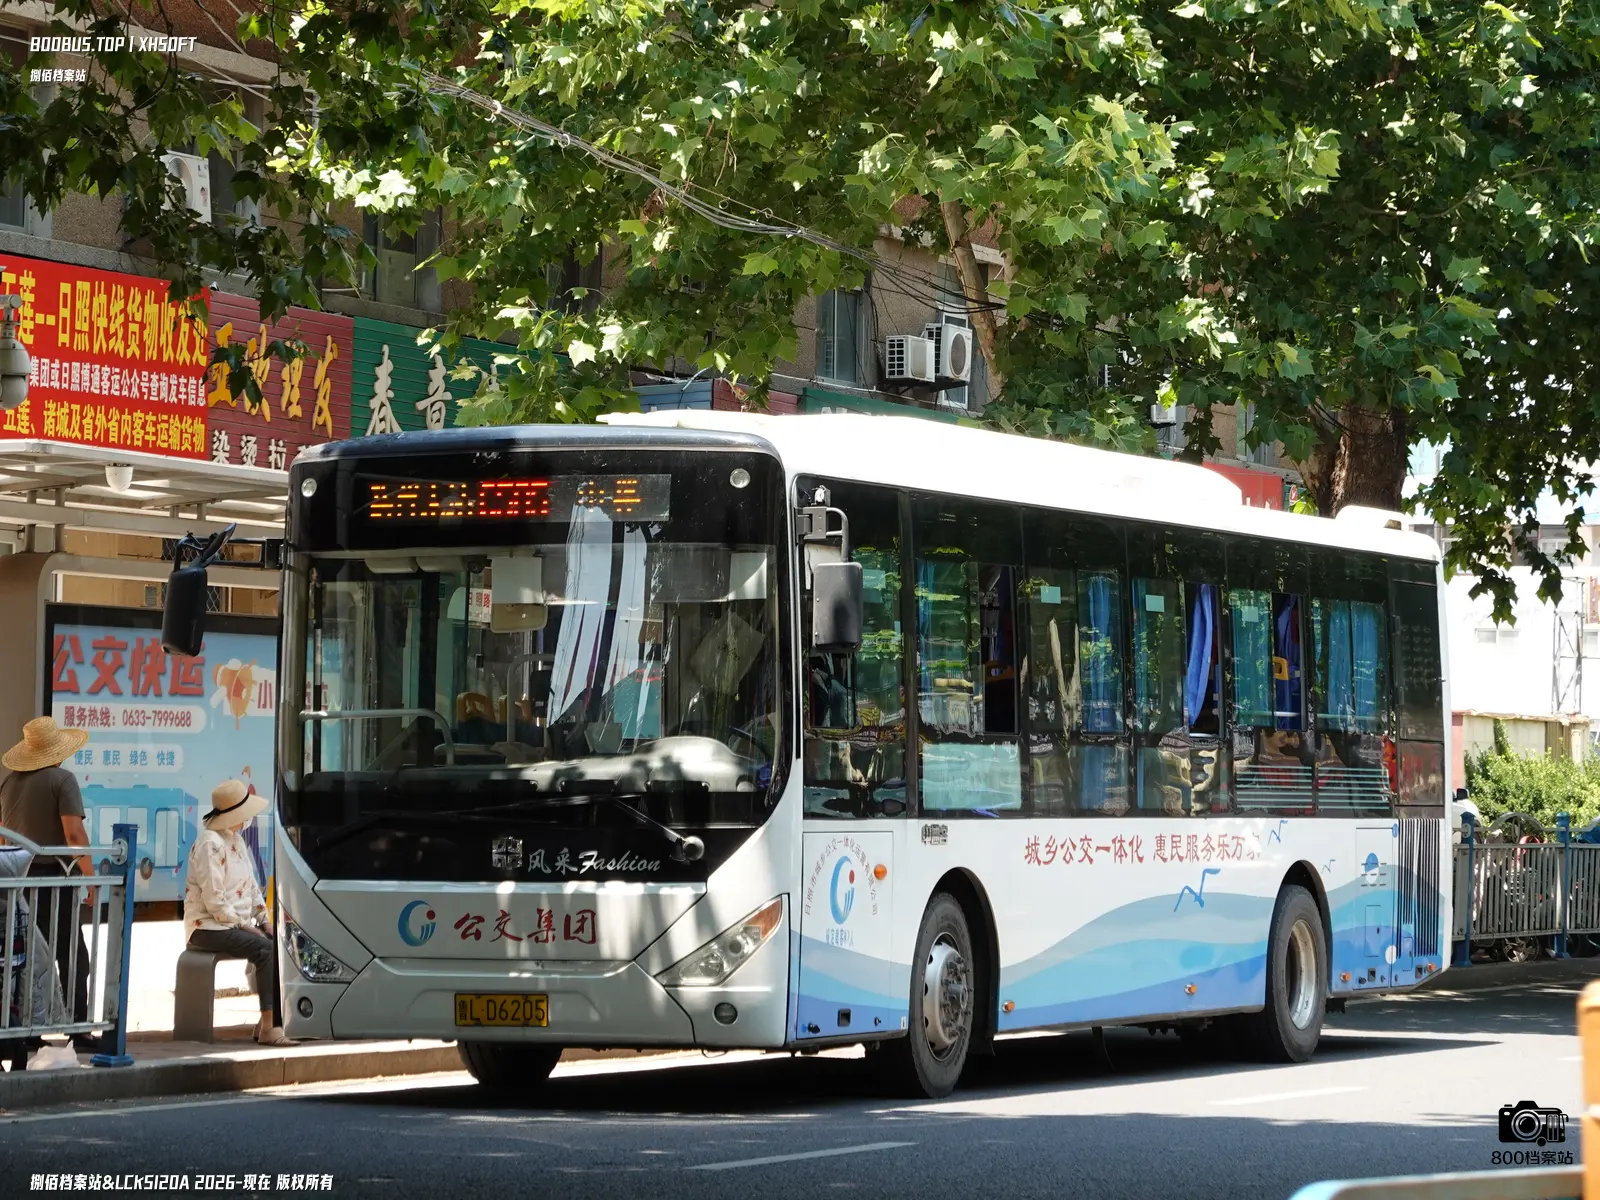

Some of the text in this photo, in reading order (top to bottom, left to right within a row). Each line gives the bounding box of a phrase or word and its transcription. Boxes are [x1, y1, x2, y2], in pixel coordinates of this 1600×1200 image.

[212, 429, 311, 471] 染烫拉
[74, 749, 176, 767] 便民 惠民 绿色 快捷
[1024, 834, 1145, 866] 城乡公交一体化
[453, 907, 597, 945] 公交集团
